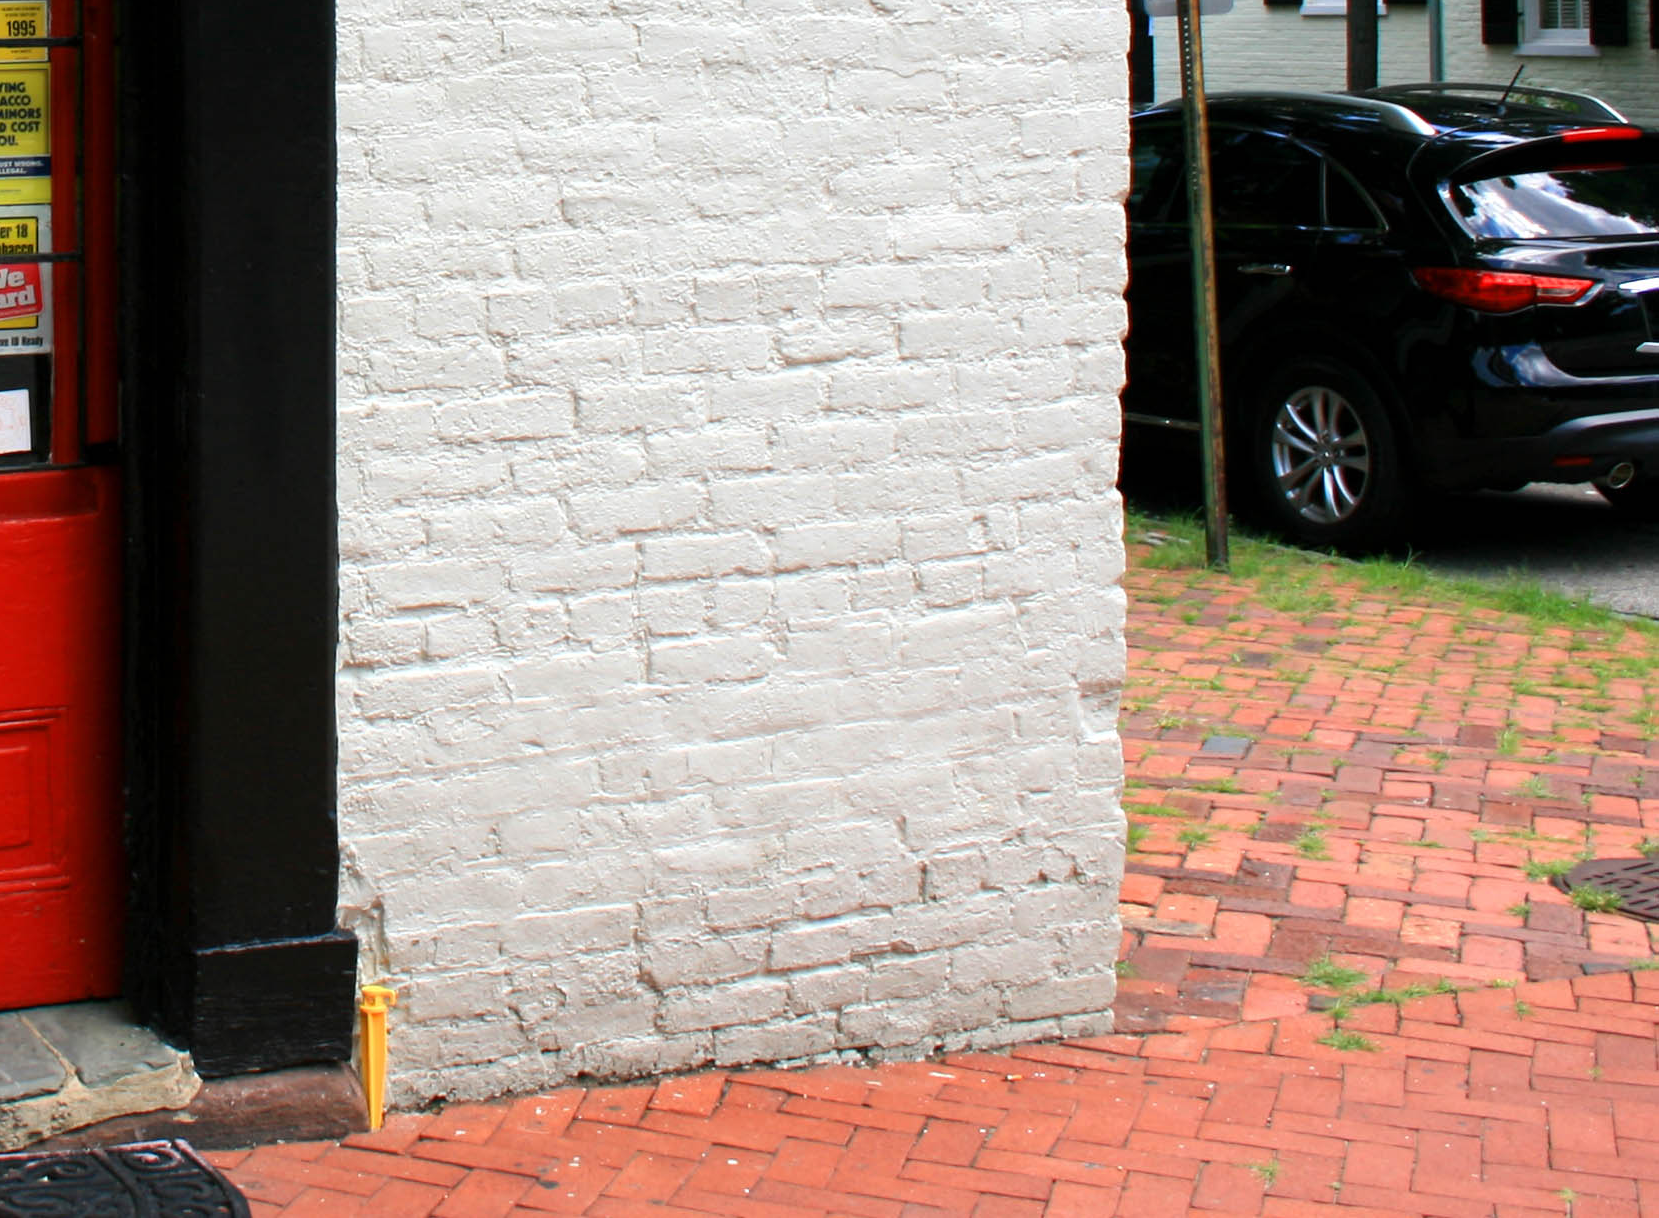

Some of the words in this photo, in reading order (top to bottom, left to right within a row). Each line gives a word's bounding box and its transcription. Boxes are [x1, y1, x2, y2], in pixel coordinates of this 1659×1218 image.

[7, 20, 37, 37] 1995
[11, 121, 41, 133] COST
[16, 223, 29, 238] 18
